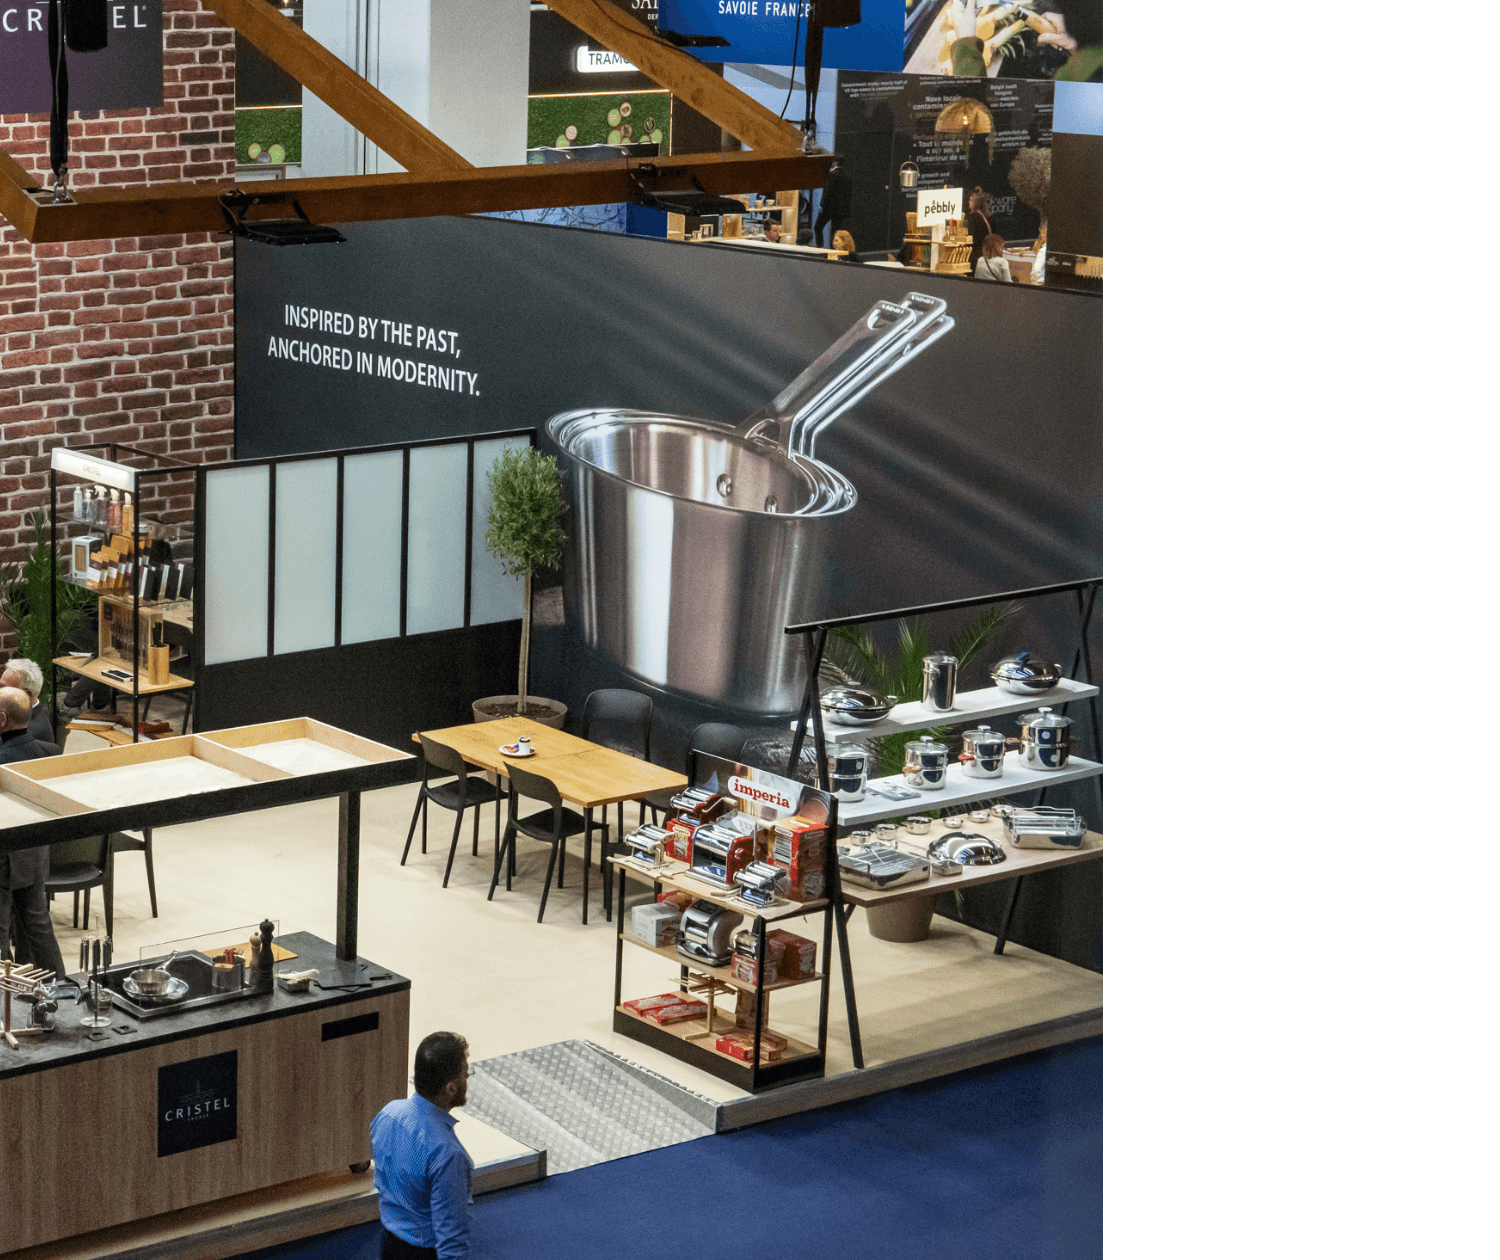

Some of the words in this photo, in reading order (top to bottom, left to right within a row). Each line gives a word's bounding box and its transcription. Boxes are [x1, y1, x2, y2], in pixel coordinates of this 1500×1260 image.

[2, 5, 147, 33] CREL
[718, 0, 757, 16] SAVOIE
[284, 304, 354, 336] INSPIRED
[358, 316, 379, 340] BY
[380, 319, 413, 347] THE
[416, 325, 461, 359] PAST,
[267, 336, 353, 371] ANCHORED
[356, 351, 373, 375] IN
[377, 354, 481, 397] MODERNITY.
[82, 464, 102, 477] CRISTEL
[734, 778, 791, 809] imperia
[165, 1097, 231, 1121] CRISTEL
